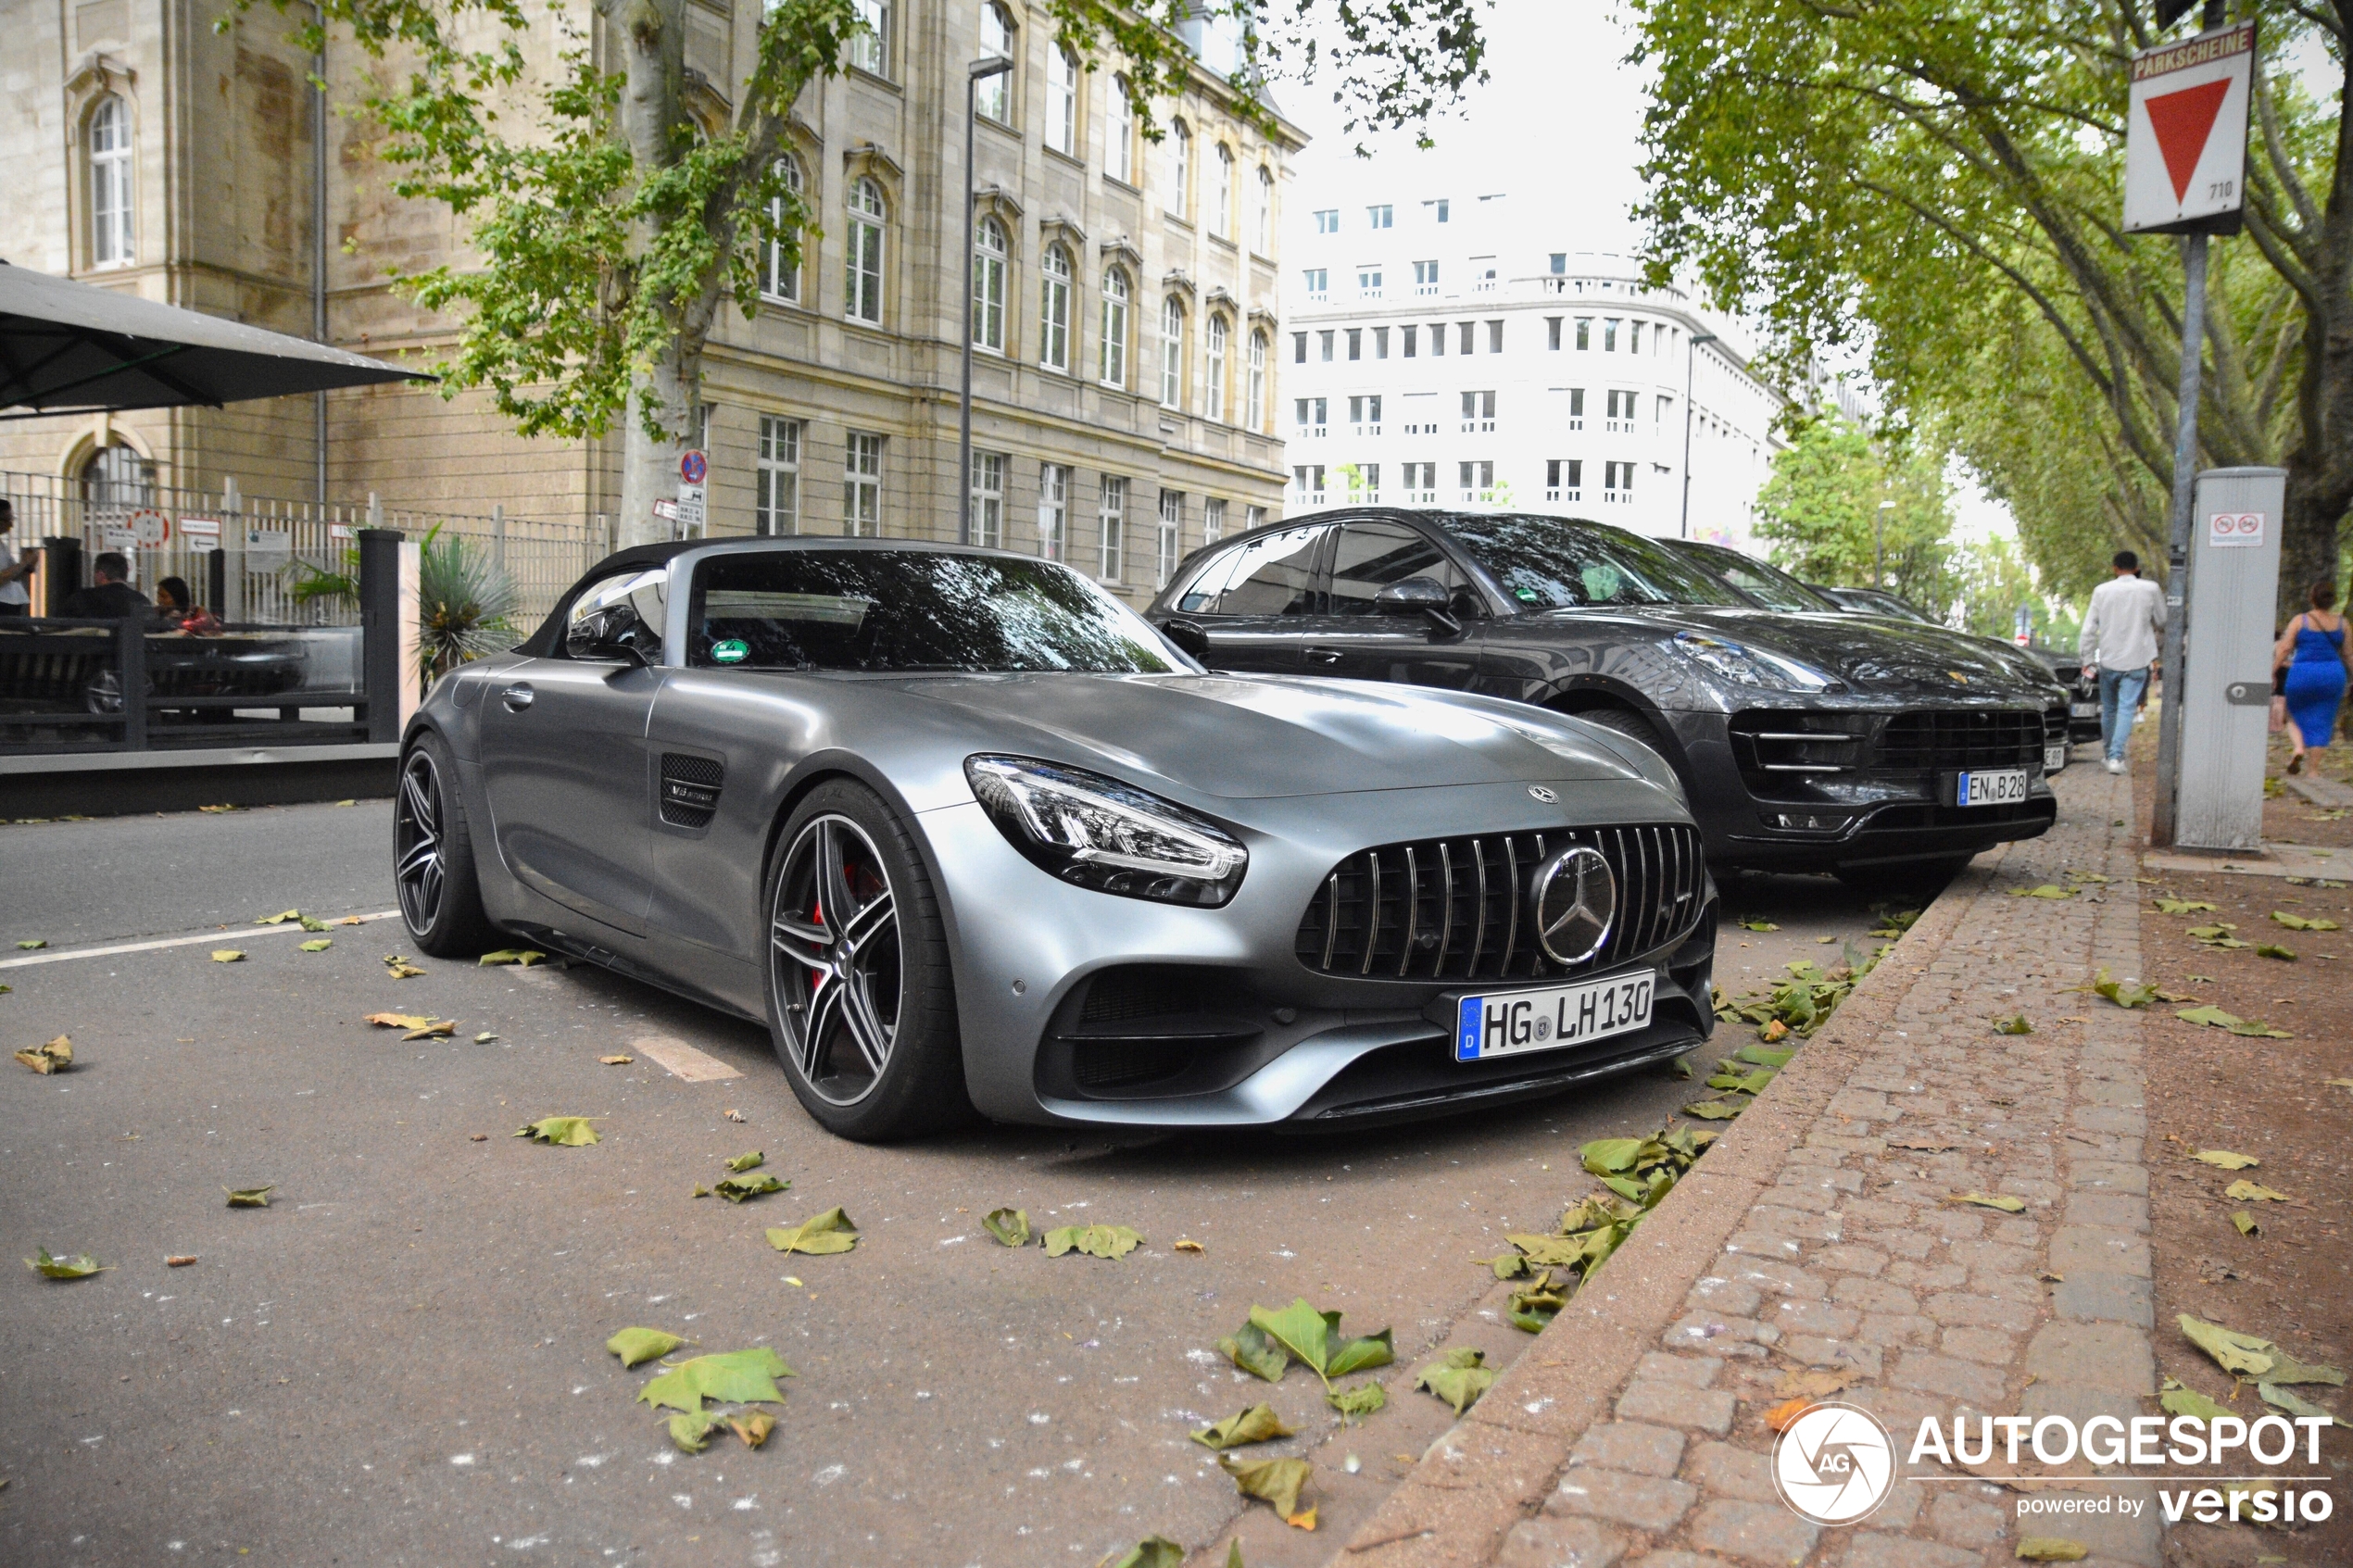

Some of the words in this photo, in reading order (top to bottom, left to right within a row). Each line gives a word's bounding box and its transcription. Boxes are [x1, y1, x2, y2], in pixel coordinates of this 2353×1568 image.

[2133, 30, 2249, 79] PARKSCHEINE
[2209, 182, 2233, 200] 710
[1969, 777, 1989, 801] EN
[1484, 1000, 1532, 1049] HG
[1465, 1035, 1475, 1048] D
